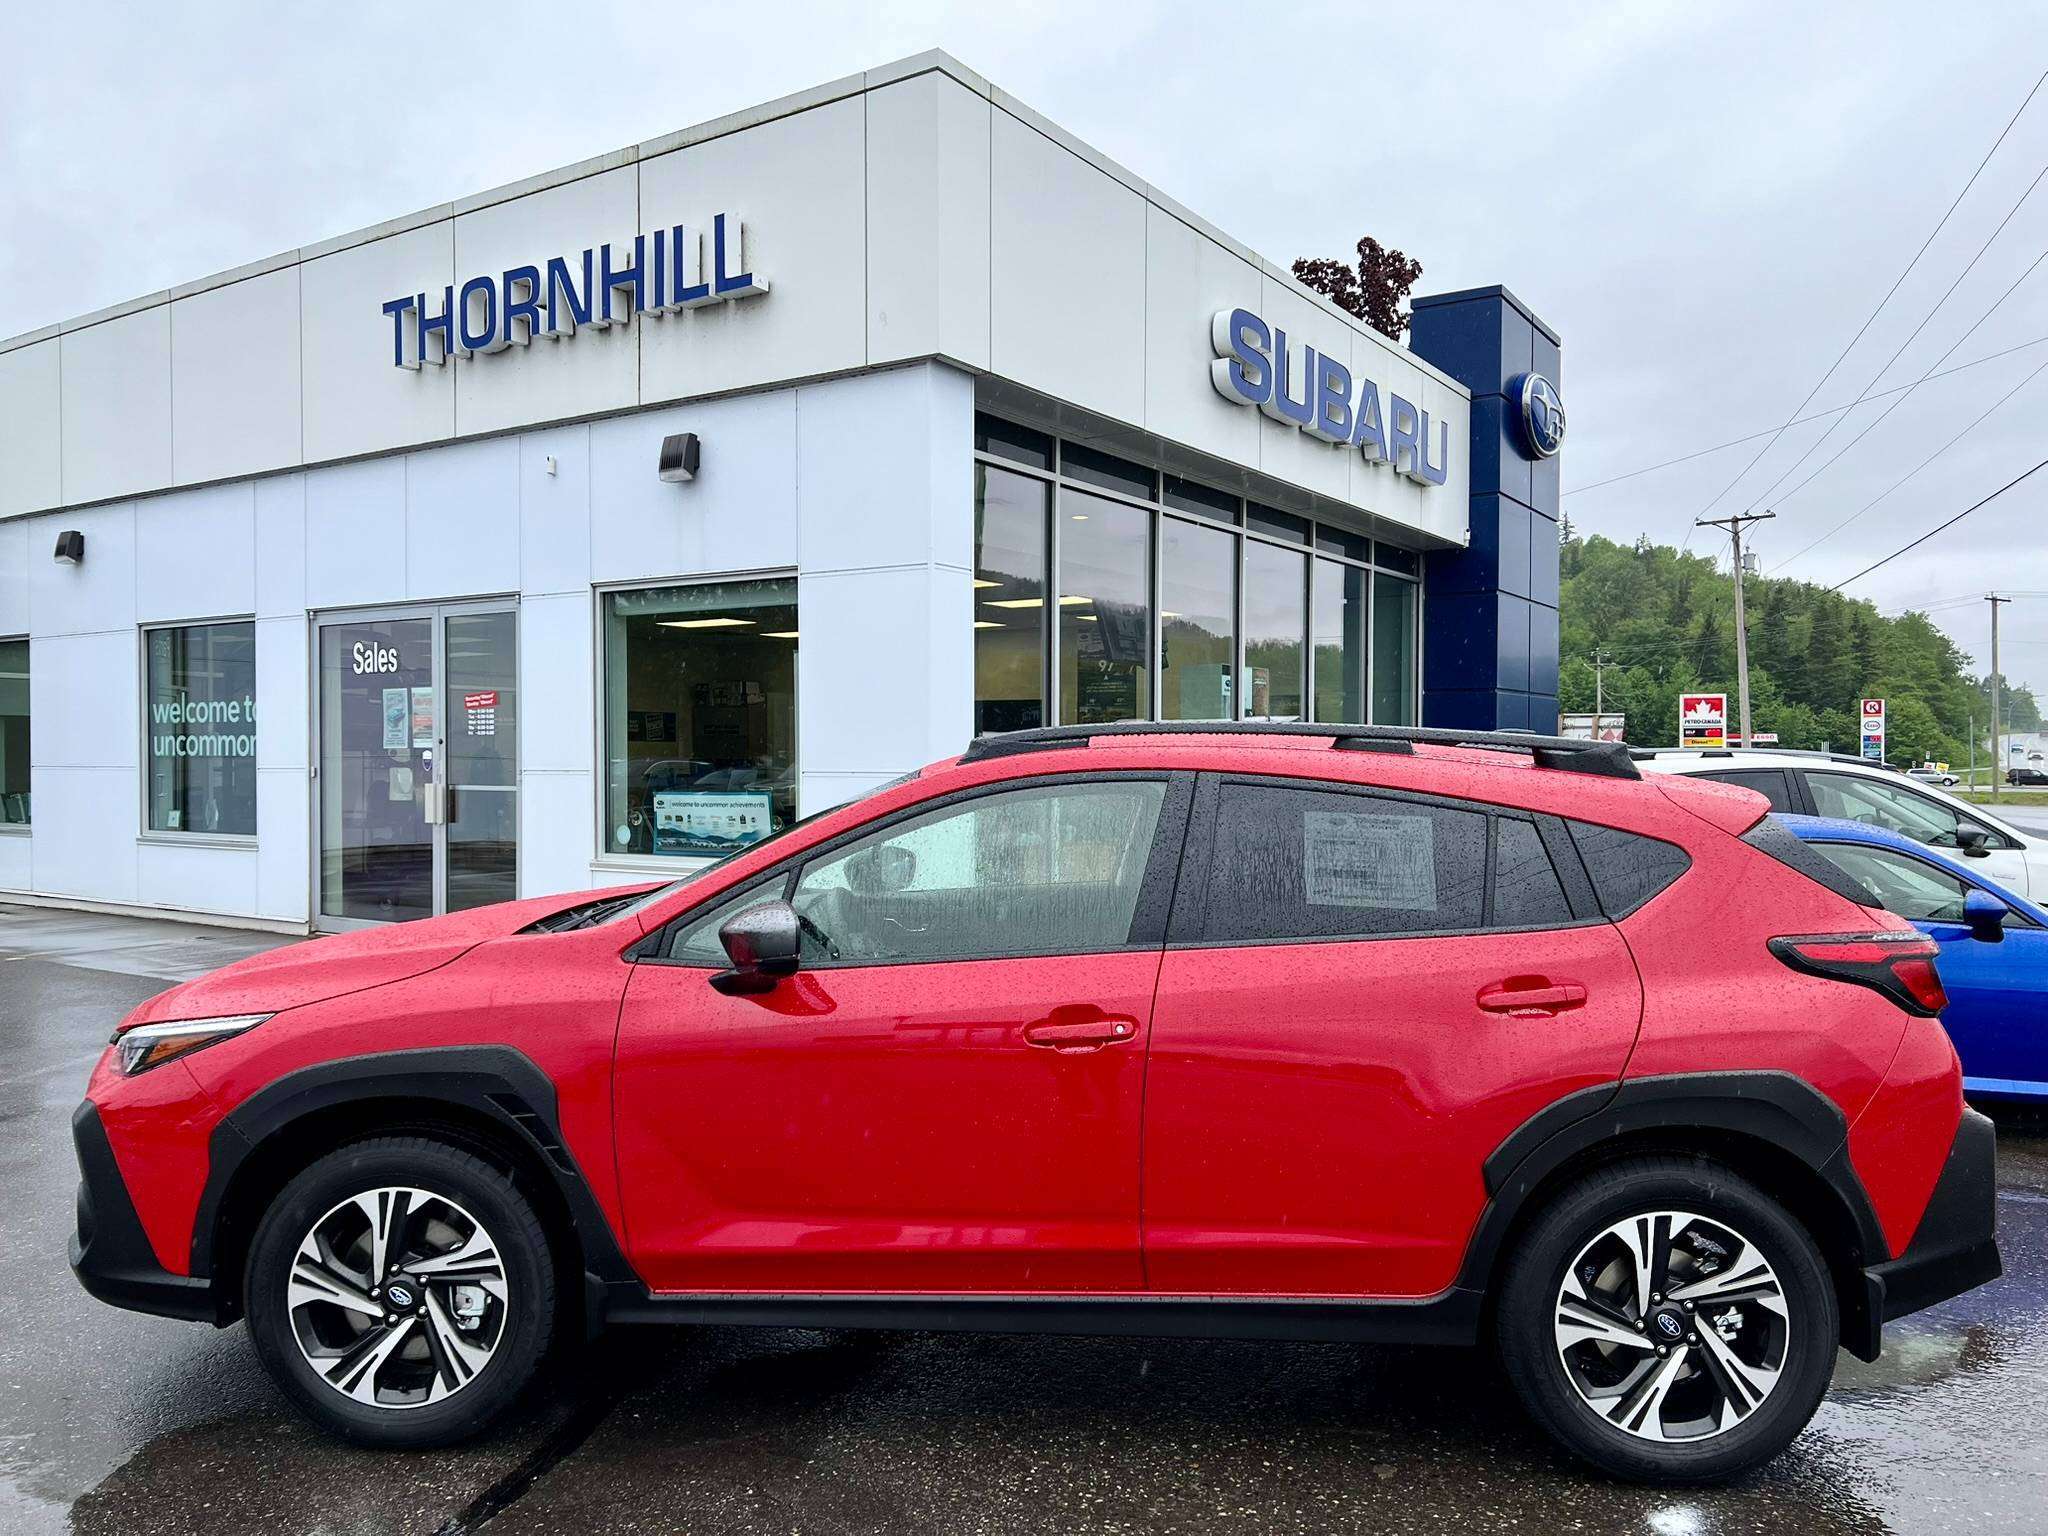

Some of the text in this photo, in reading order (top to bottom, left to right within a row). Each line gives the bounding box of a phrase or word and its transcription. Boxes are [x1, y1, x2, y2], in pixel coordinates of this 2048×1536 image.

[382, 213, 768, 370] THORNHILL
[1214, 308, 1448, 487] SUBARU
[353, 641, 398, 675] Sales
[152, 692, 241, 724] welcome
[672, 800, 693, 808] welcome
[694, 800, 700, 808] to
[730, 801, 765, 809] achievements
